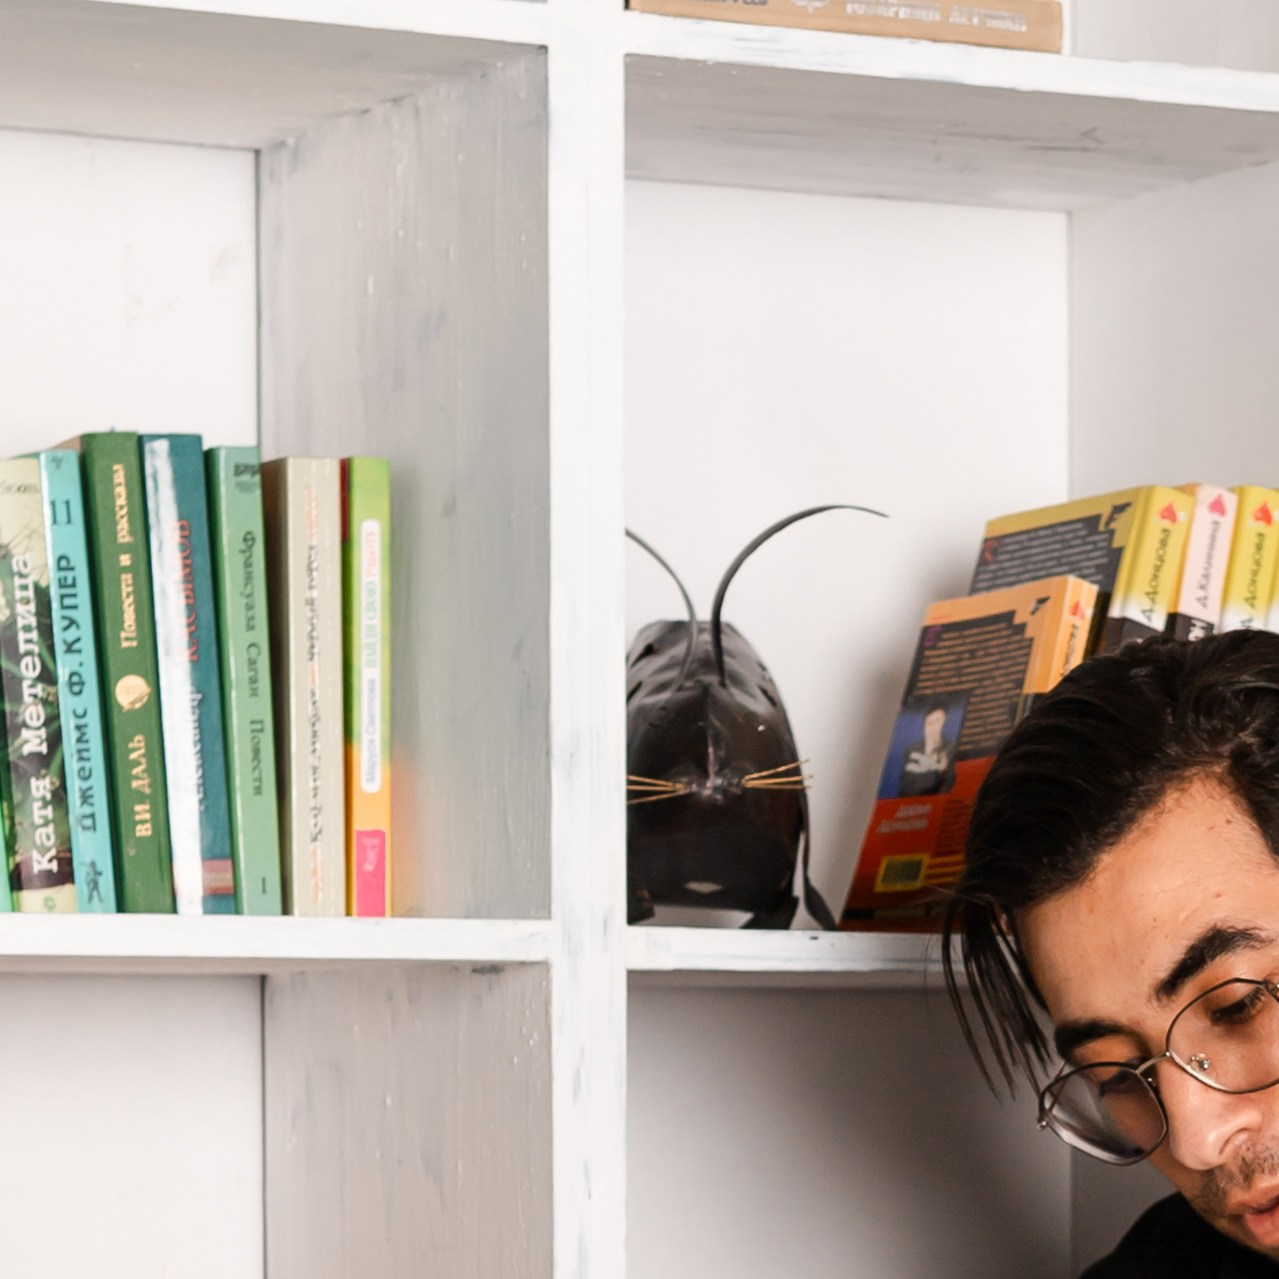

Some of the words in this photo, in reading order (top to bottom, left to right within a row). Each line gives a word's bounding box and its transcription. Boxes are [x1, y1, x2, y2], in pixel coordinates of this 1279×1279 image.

[50, 498, 74, 526] 11
[113, 463, 132, 543] рассказы
[56, 553, 82, 653] КУПЕР
[118, 574, 138, 649] Повести
[169, 518, 199, 662] КАСЫМОВ
[240, 530, 259, 634] Франсуаза
[17, 552, 51, 757] Метелица
[246, 641, 261, 699] Саган
[71, 708, 98, 832] Джеймс
[128, 733, 152, 795] ДАЛЬ
[249, 717, 264, 797] Повести
[364, 740, 378, 783] Маруся
[30, 774, 58, 874] Катя
